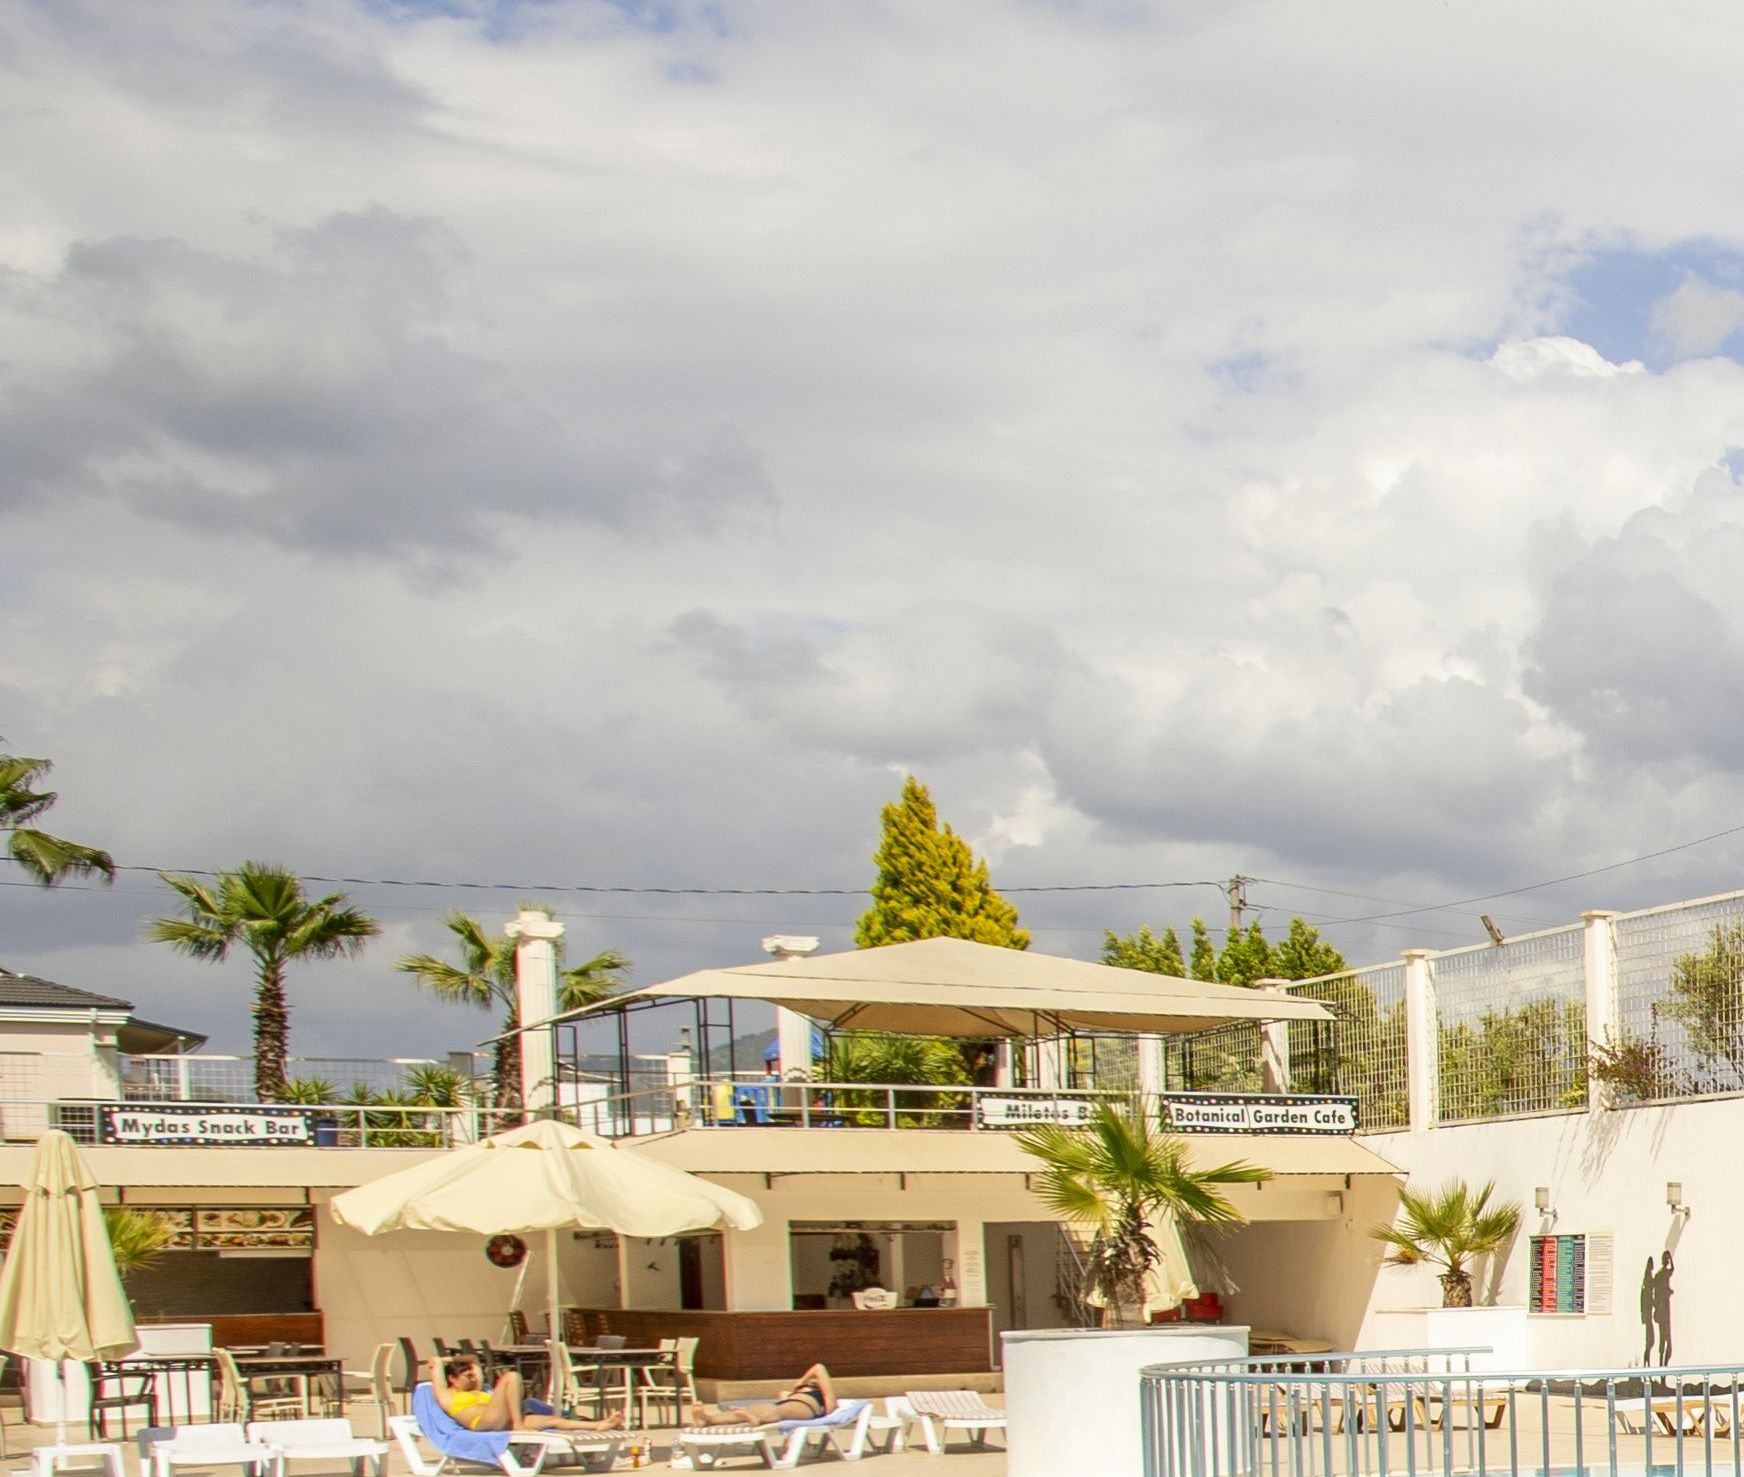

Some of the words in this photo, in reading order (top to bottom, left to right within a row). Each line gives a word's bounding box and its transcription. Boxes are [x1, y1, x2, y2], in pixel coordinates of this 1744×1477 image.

[1175, 1108, 1245, 1123] Botanical
[1253, 1109, 1308, 1124] Garden
[1314, 1110, 1346, 1124] Cafe
[121, 1118, 190, 1136] Mydas
[199, 1119, 255, 1135] Snack
[265, 1121, 300, 1135] Bar
